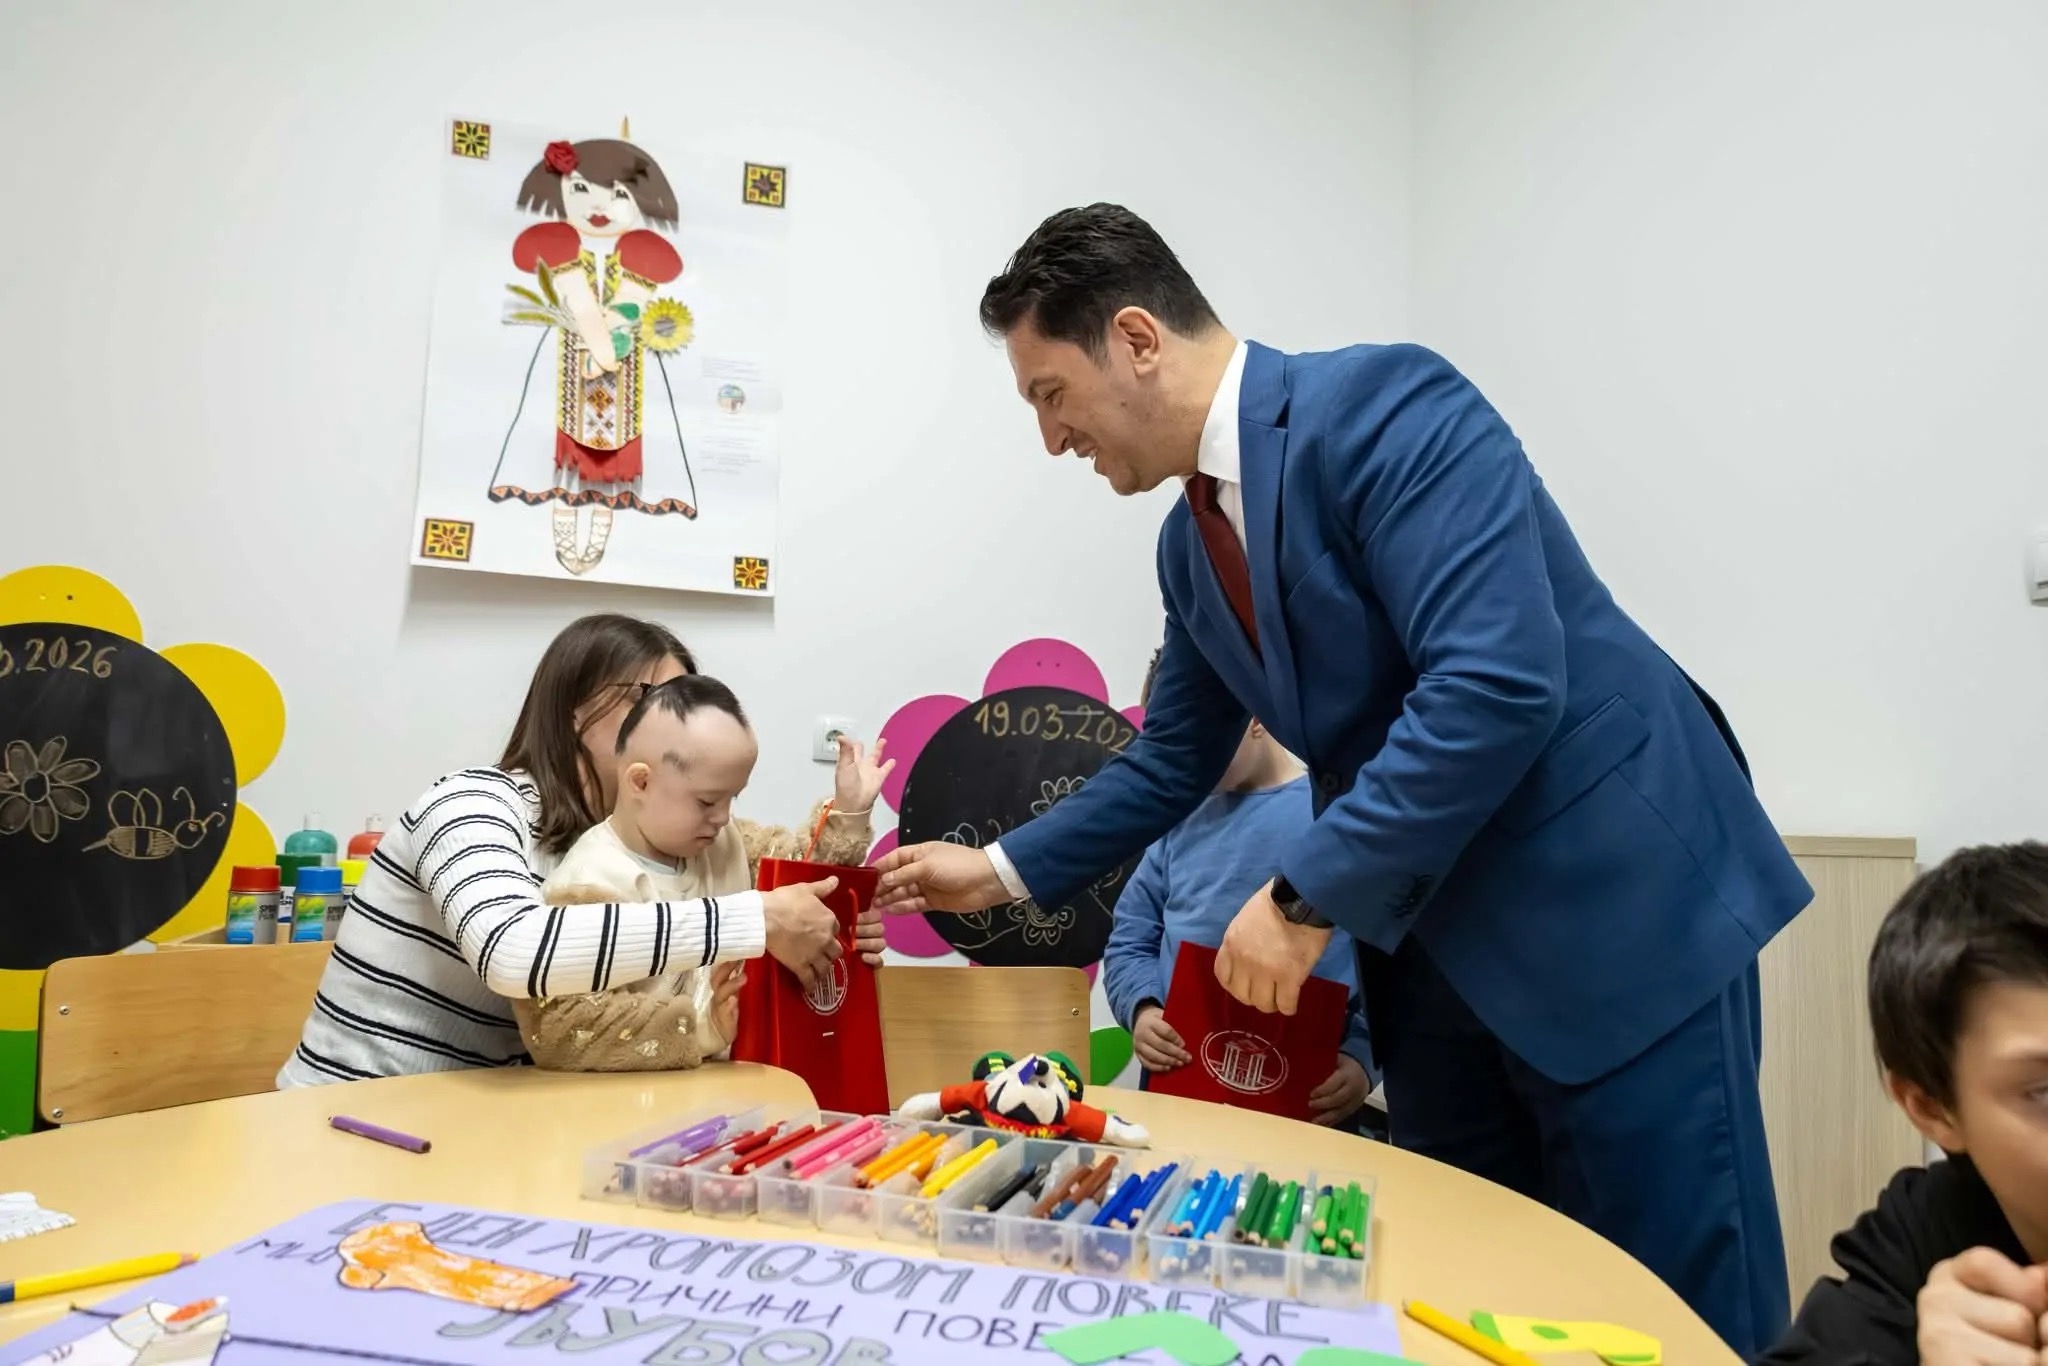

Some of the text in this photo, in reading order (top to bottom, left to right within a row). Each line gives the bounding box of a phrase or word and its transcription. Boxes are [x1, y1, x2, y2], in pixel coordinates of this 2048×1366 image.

[974, 701, 1134, 755] 19.03.202
[527, 1227, 974, 1304] ХРОМОЗОМ
[569, 1271, 843, 1328] ПРИЧИНИ
